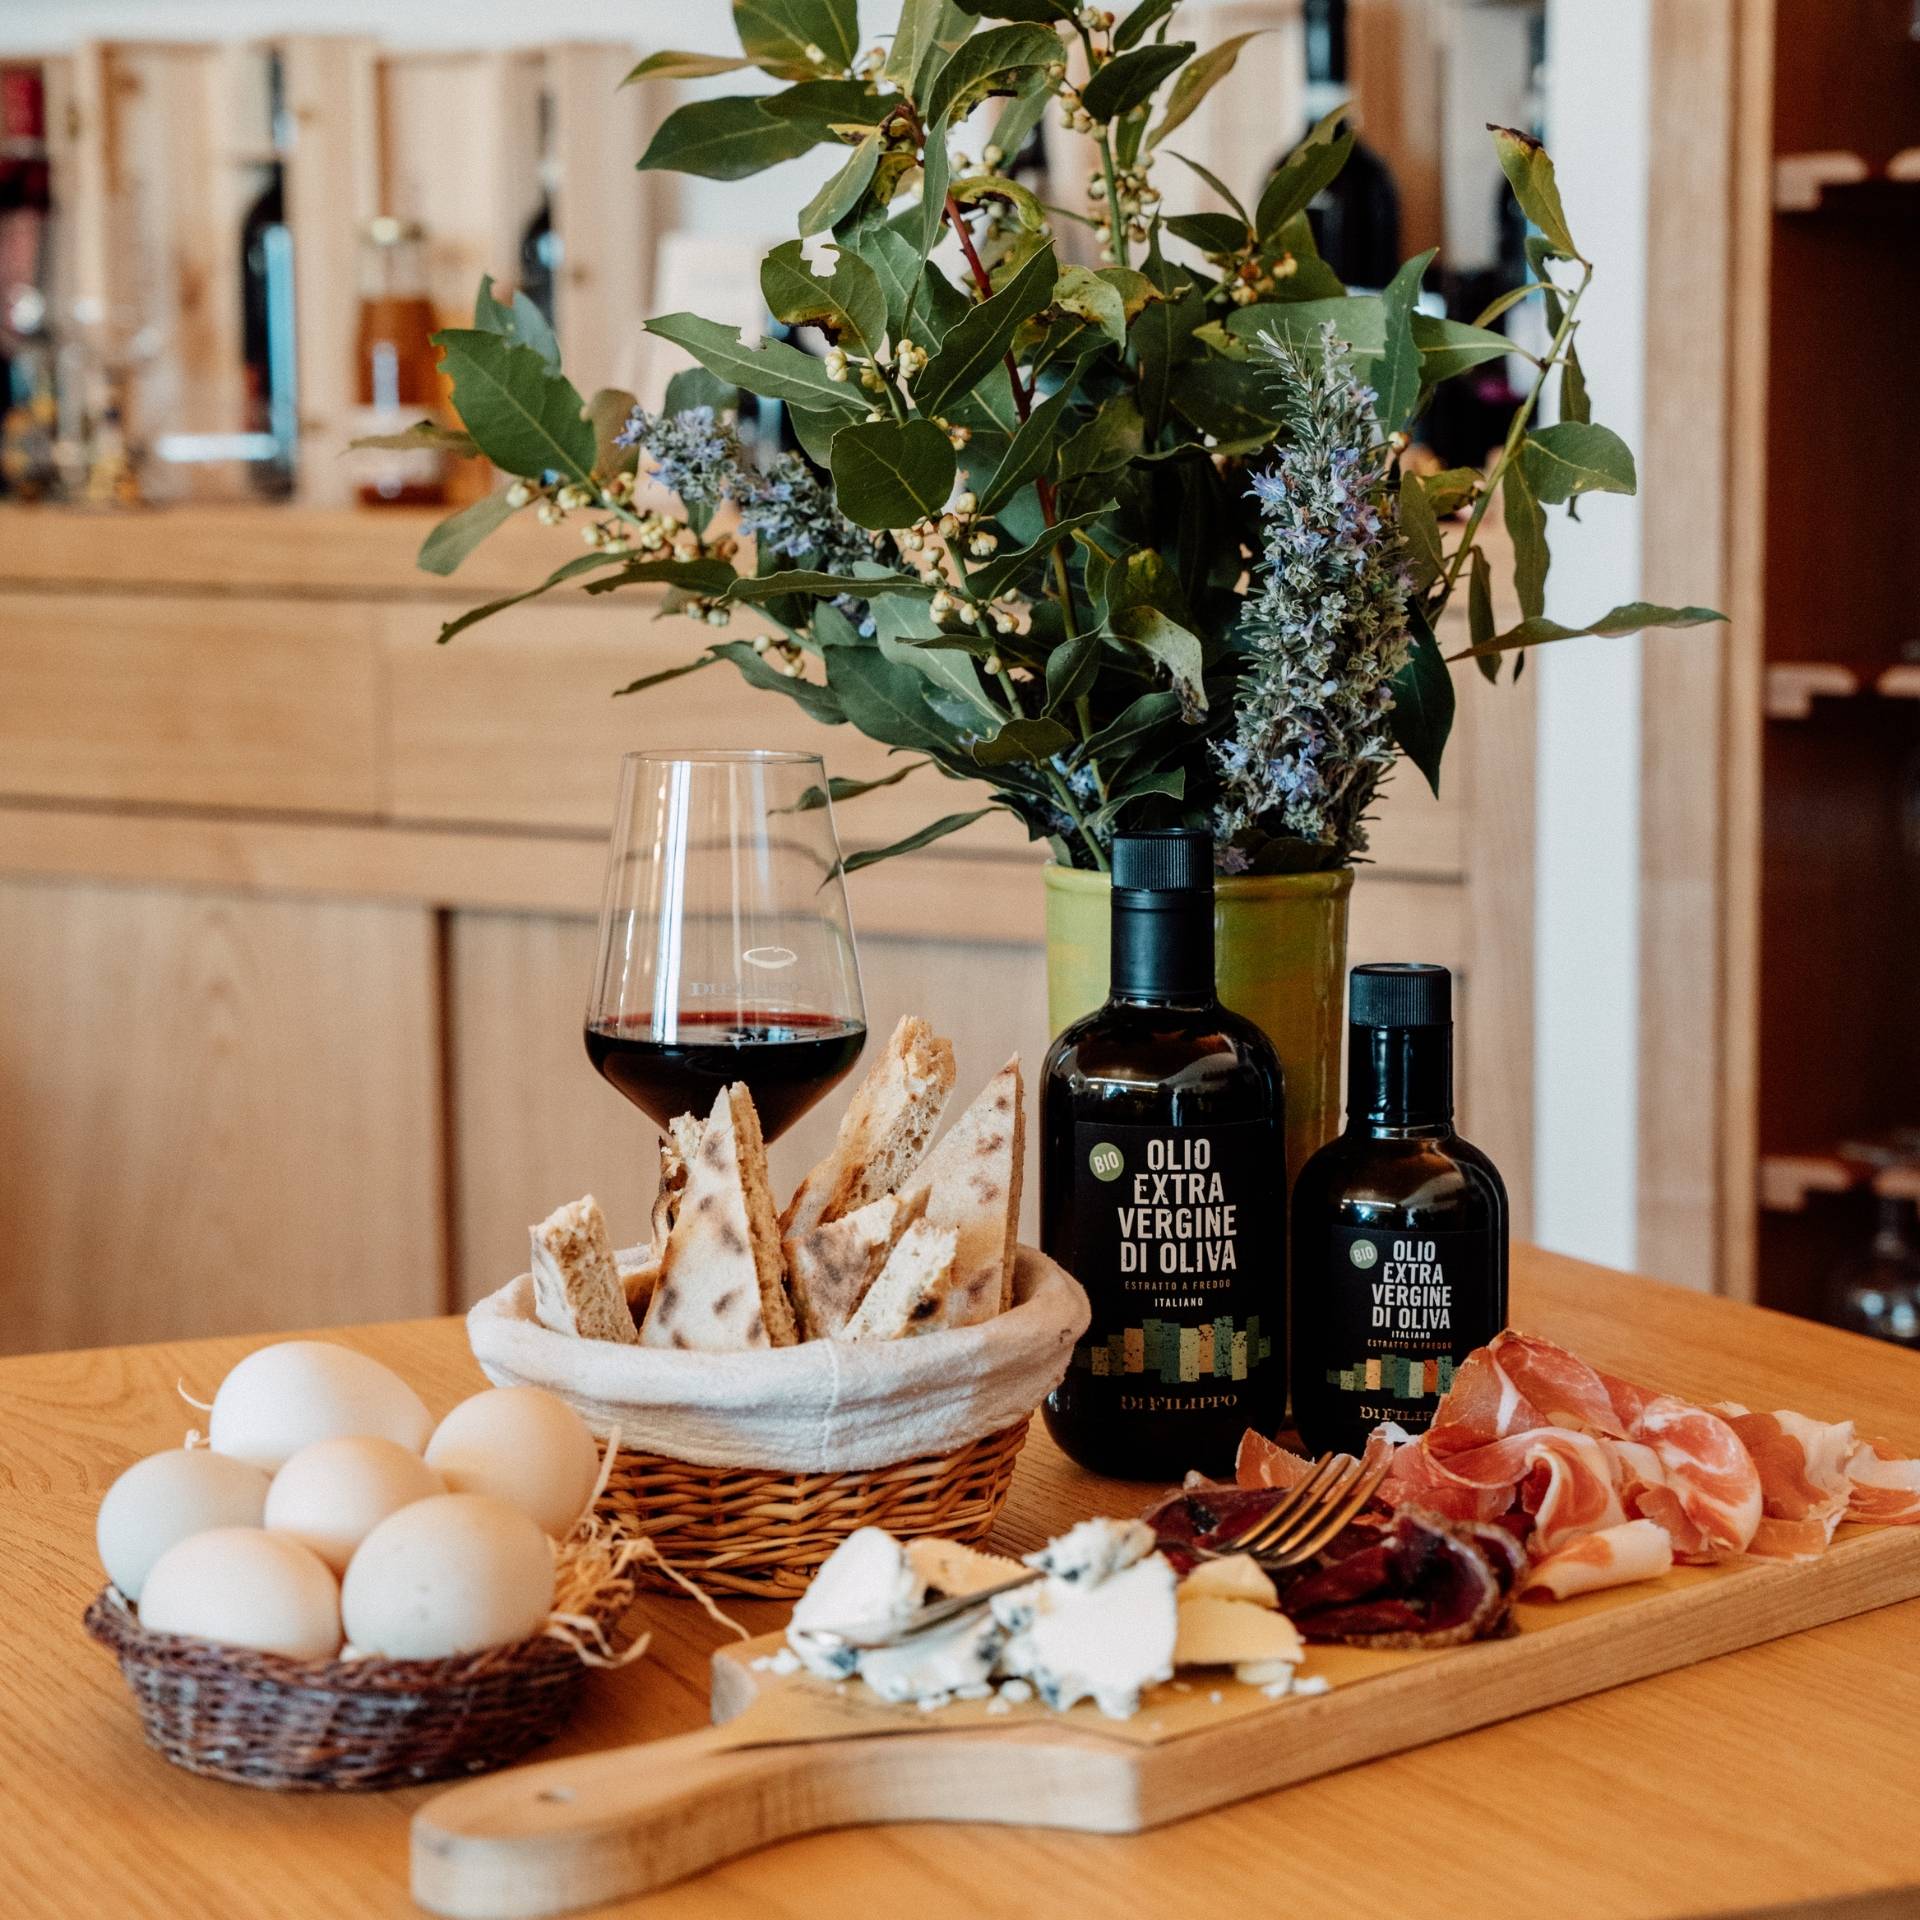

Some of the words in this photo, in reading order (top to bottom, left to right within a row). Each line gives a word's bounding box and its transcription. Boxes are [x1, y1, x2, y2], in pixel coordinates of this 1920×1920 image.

[1094, 1151, 1120, 1173] BIO
[1147, 1138, 1211, 1170] OLIO
[1133, 1172, 1225, 1205] EXTRA
[1117, 1204, 1238, 1239] VERGINE
[1120, 1241, 1147, 1273] DI
[1159, 1239, 1237, 1274] OLIVA
[1353, 1246, 1375, 1263] BIO
[1393, 1240, 1436, 1262] OLIO
[1383, 1262, 1444, 1285] EXTRA
[1124, 1281, 1177, 1291] ESTRATTO
[1182, 1281, 1188, 1290] A
[1371, 1283, 1452, 1307] VERGINE
[1154, 1297, 1204, 1308] ITALIANO
[1372, 1306, 1391, 1328] DI
[1398, 1307, 1451, 1329] OLIVA
[1391, 1330, 1431, 1339] ITALIANO
